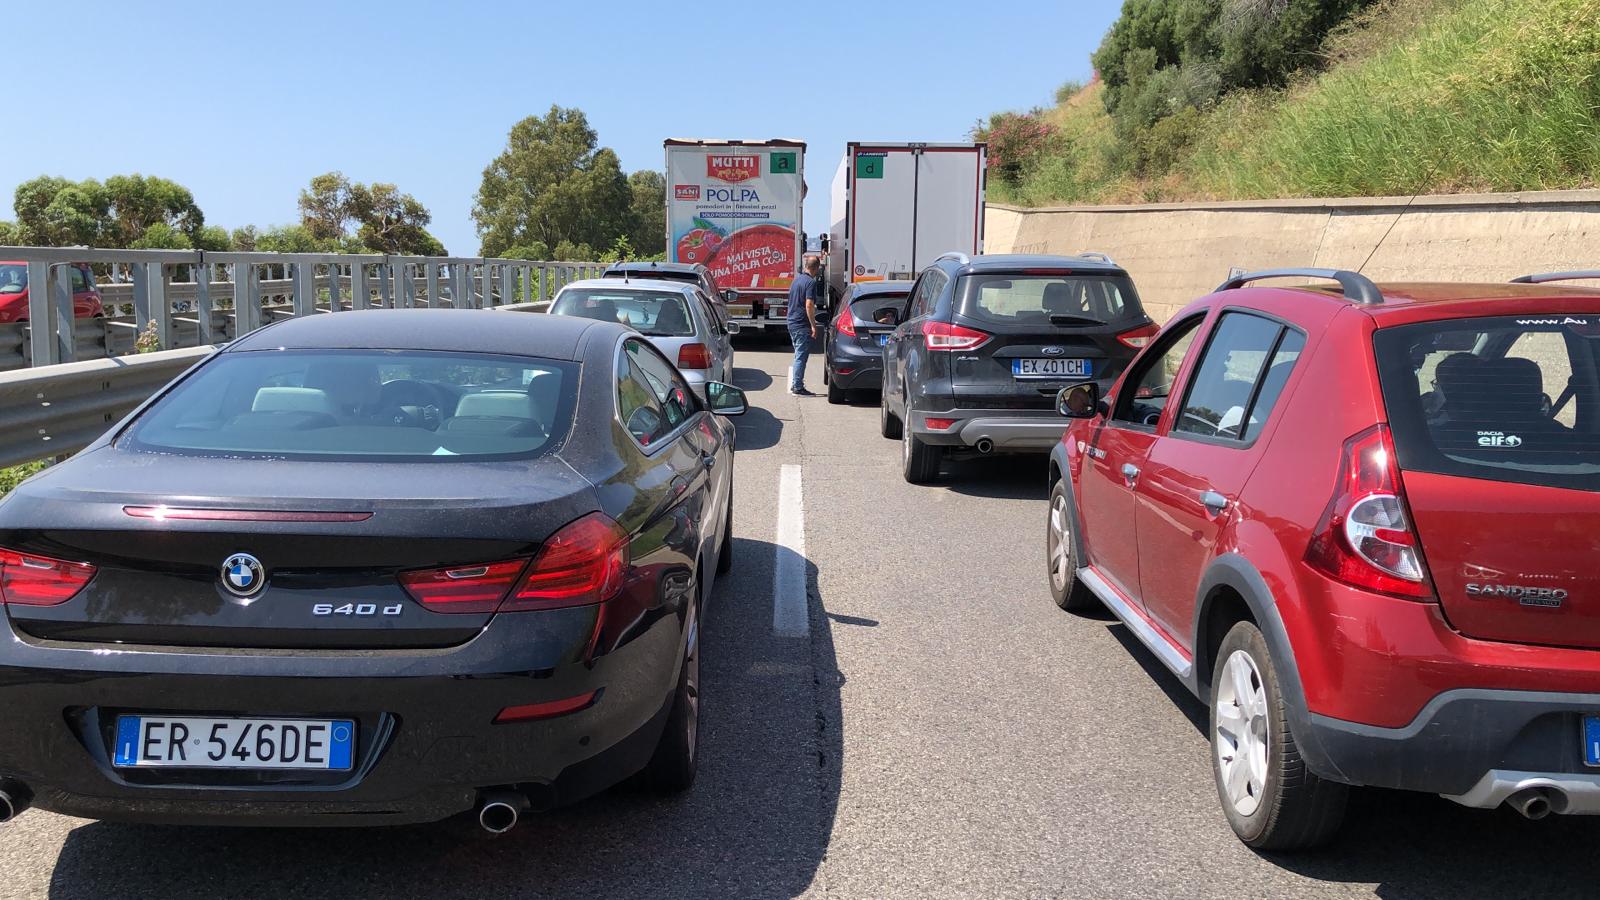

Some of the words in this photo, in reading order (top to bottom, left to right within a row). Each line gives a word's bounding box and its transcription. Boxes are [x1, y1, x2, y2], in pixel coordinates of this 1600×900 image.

[712, 157, 754, 168] MUTTI
[778, 158, 788, 169] a
[865, 162, 874, 174] d
[707, 189, 760, 202] POLPA
[746, 247, 770, 259] VISTA
[732, 260, 760, 273] POLPA
[1023, 359, 1038, 373] EX
[1043, 360, 1083, 374] 401CH
[1465, 583, 1568, 598] SANDERO
[312, 603, 375, 616] 640
[382, 603, 402, 616] d
[142, 722, 189, 761] ER
[207, 723, 326, 763] 546DE
